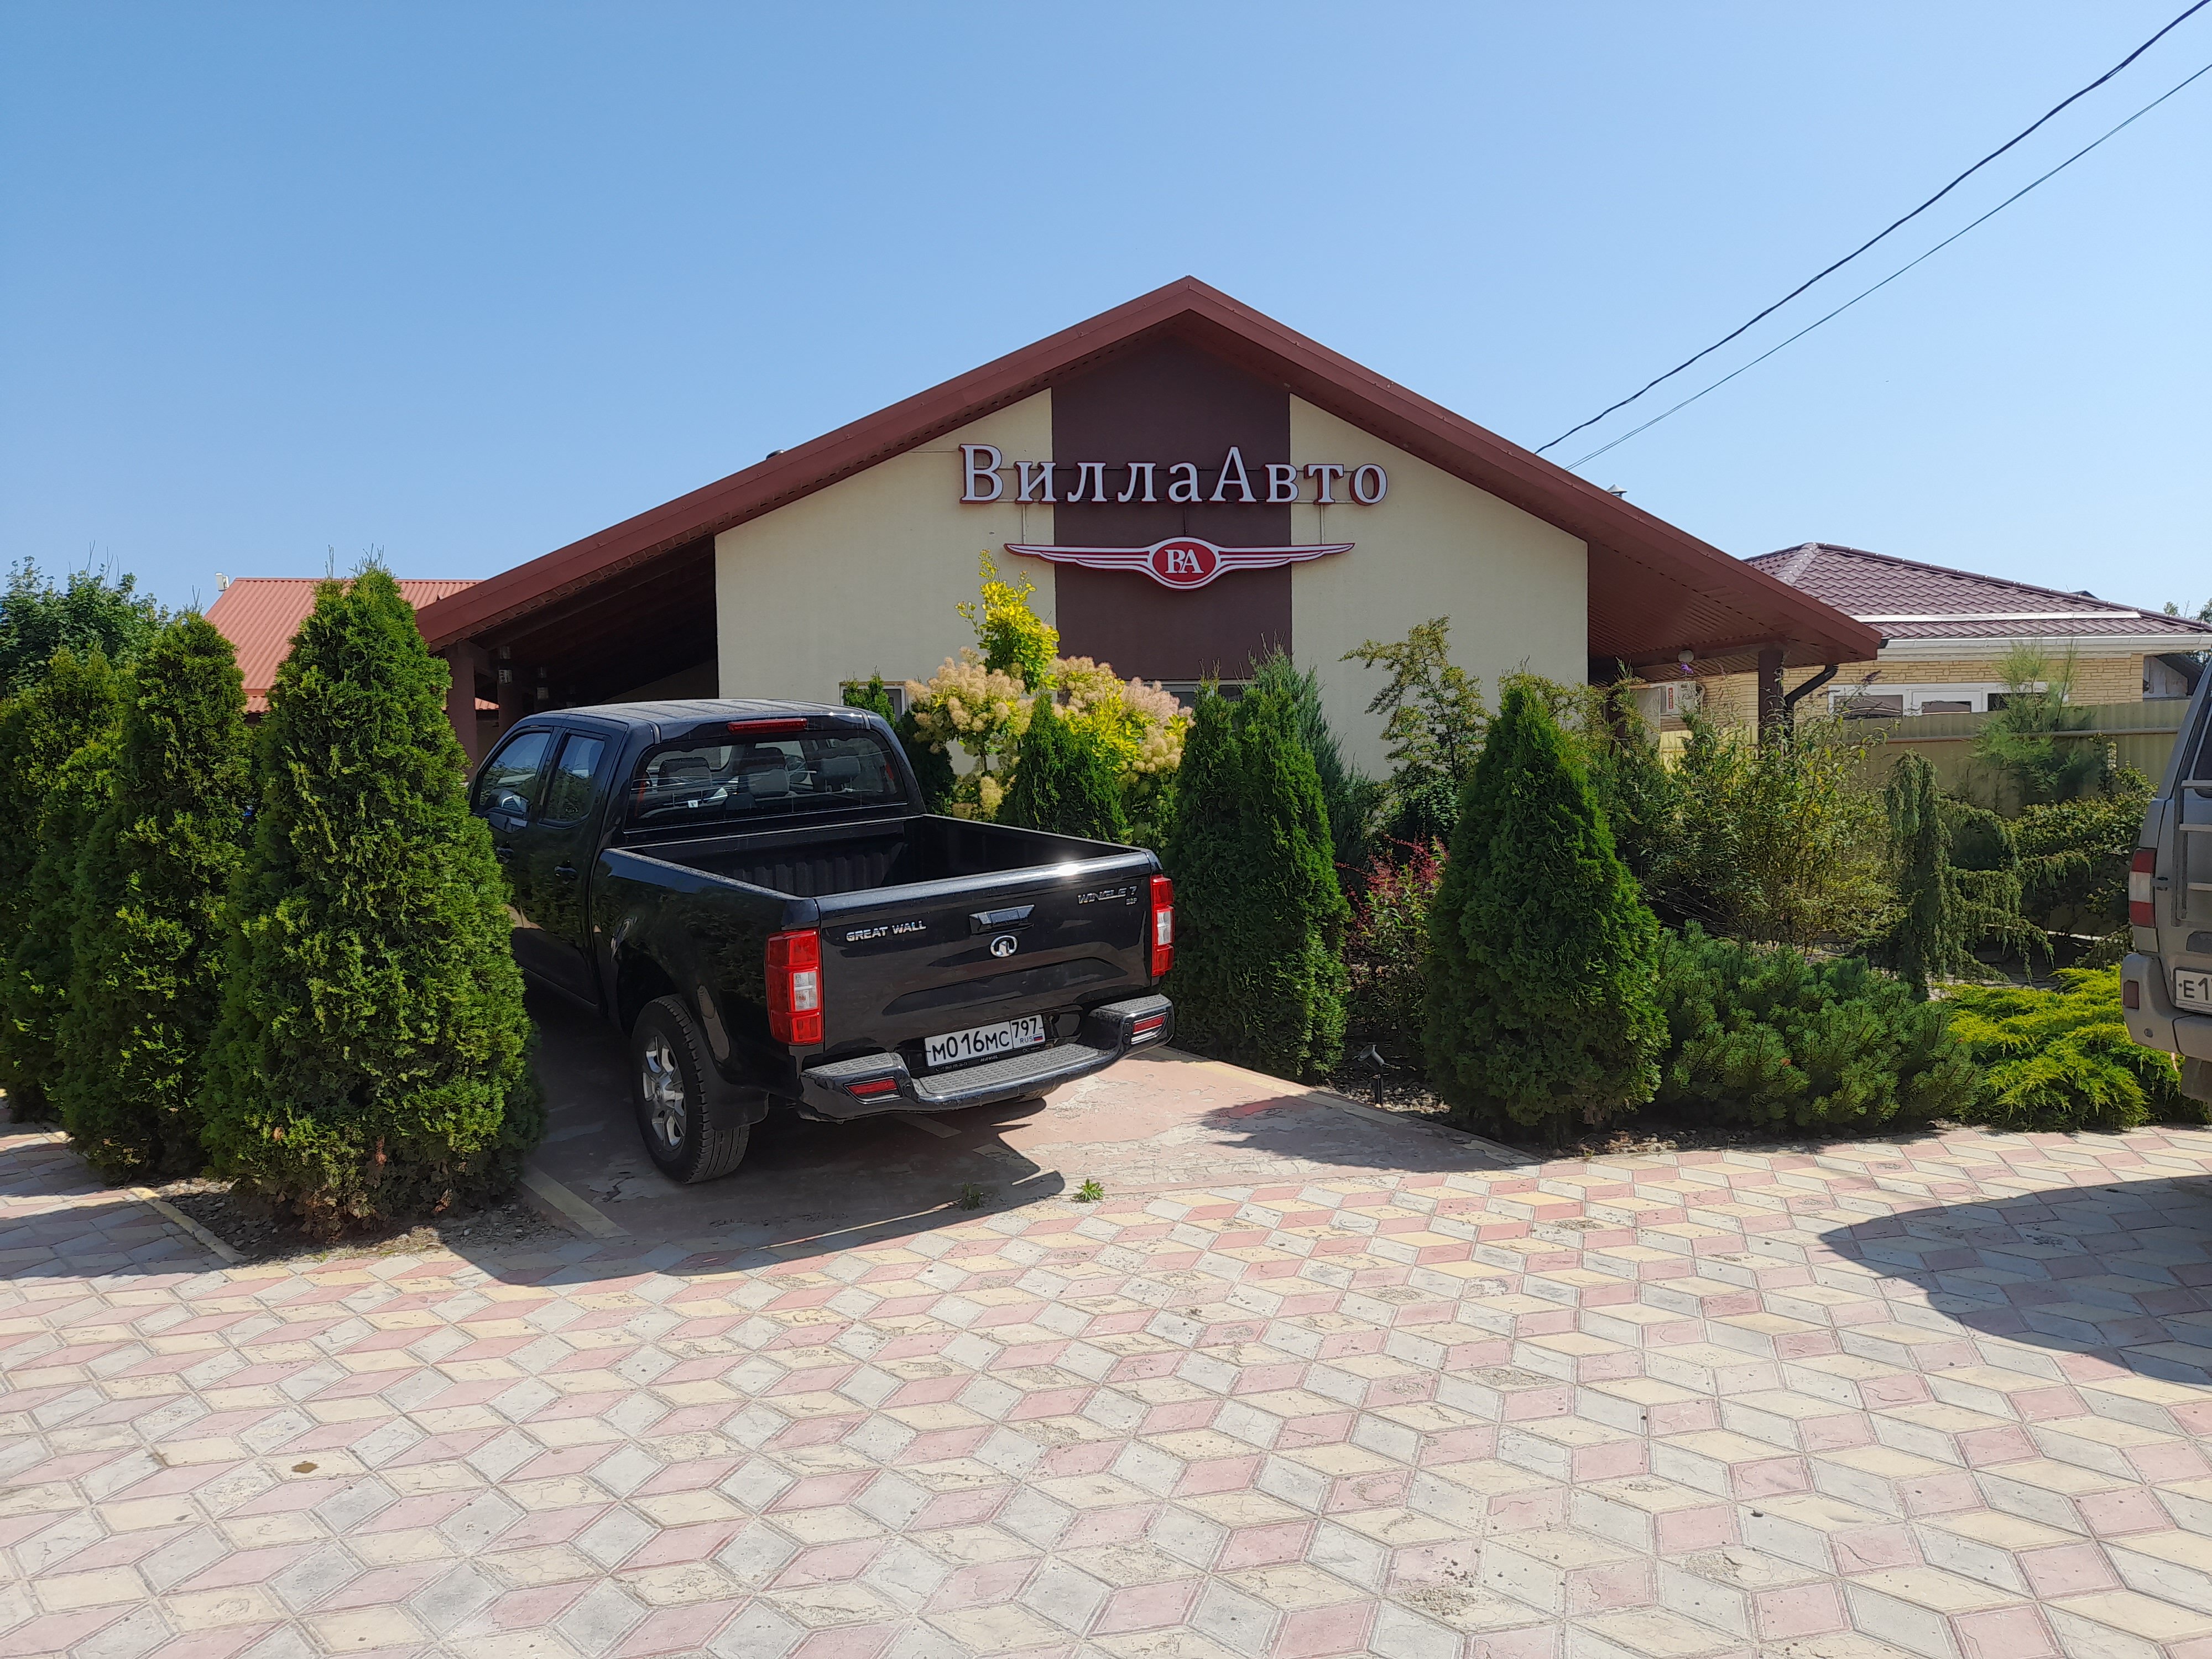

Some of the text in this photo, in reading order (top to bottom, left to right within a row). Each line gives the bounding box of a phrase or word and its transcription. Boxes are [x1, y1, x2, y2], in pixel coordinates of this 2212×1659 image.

[958, 444, 1388, 505] ВиллаАвто
[1130, 886, 1138, 895] 7
[846, 920, 927, 942] GREAT WALL
[2183, 977, 2212, 1001] Е1
[1011, 1017, 1037, 1039] 797
[1020, 1036, 1033, 1044] RUS
